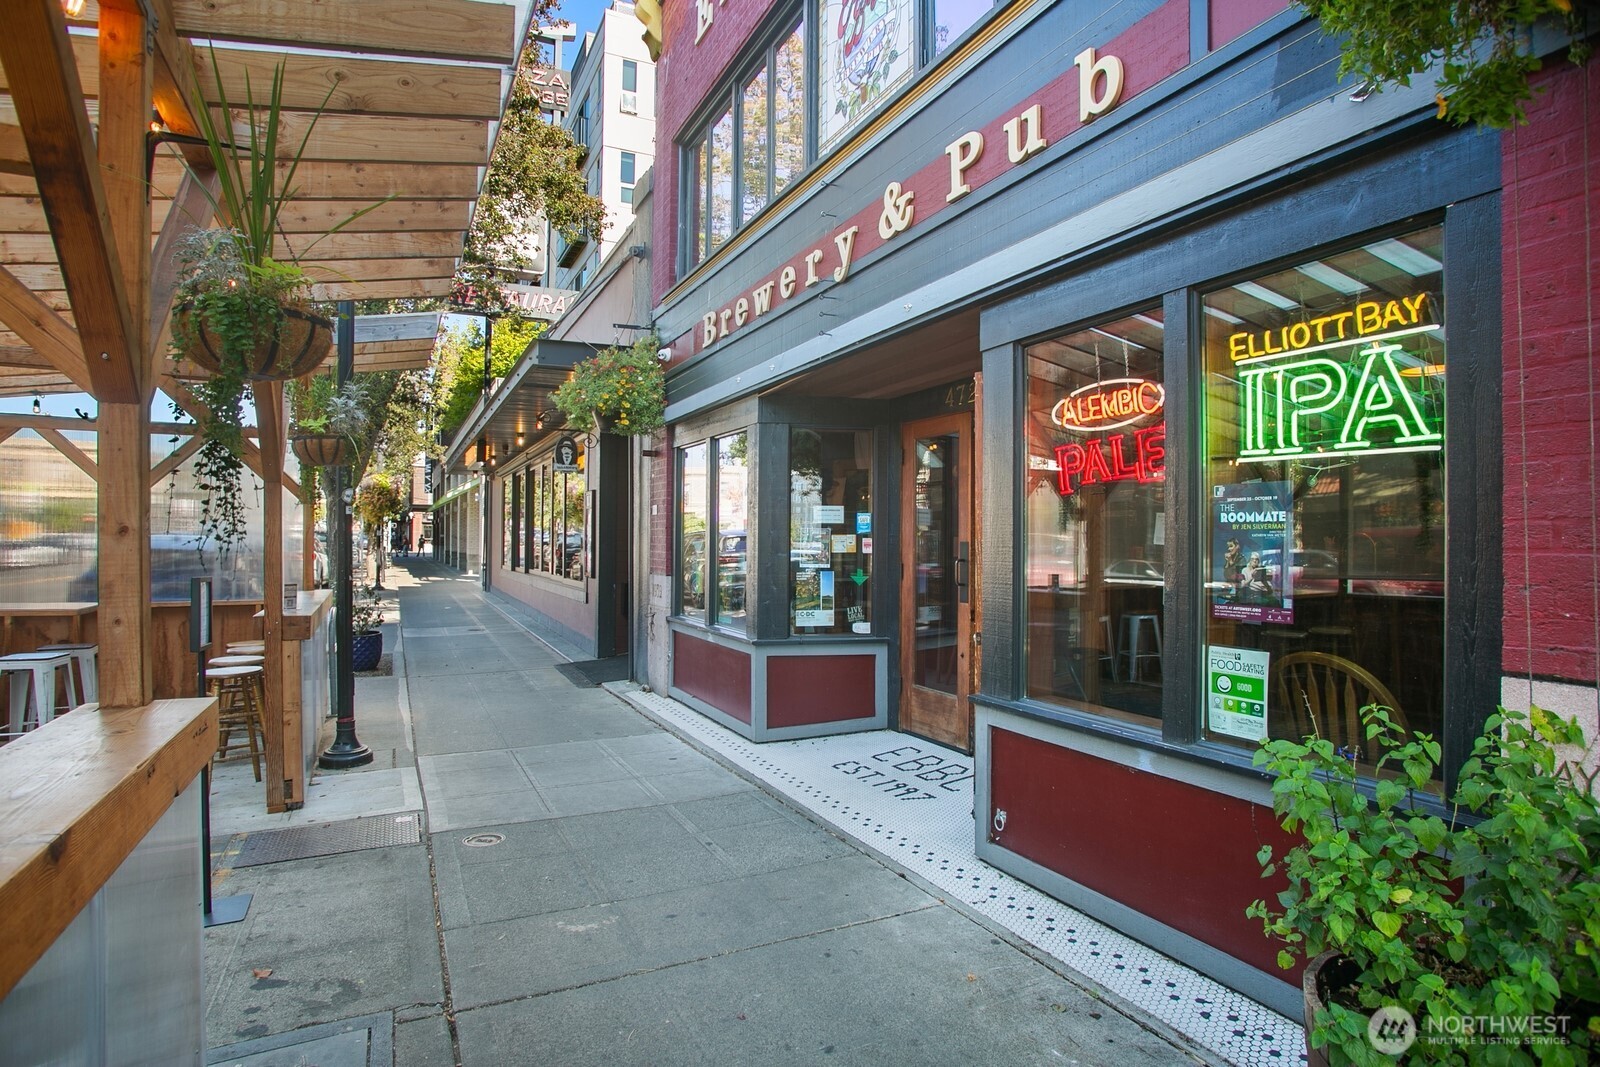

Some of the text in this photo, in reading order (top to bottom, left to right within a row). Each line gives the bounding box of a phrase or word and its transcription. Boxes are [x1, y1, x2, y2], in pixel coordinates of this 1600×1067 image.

[702, 47, 1125, 348] Brewery & Pub
[1229, 293, 1425, 361] ELLIOTT BAY
[1062, 382, 1160, 427] ALEMBIC
[1238, 344, 1441, 455] IPA
[1054, 421, 1165, 495] PALE
[1220, 504, 1235, 512] THE
[1220, 511, 1287, 523] ROOMMATE
[847, 605, 863, 615] LIVE
[1211, 659, 1242, 672] FOOD
[1243, 667, 1265, 675] RATING
[1237, 683, 1253, 693] GOOD
[872, 778, 937, 801] 1997
